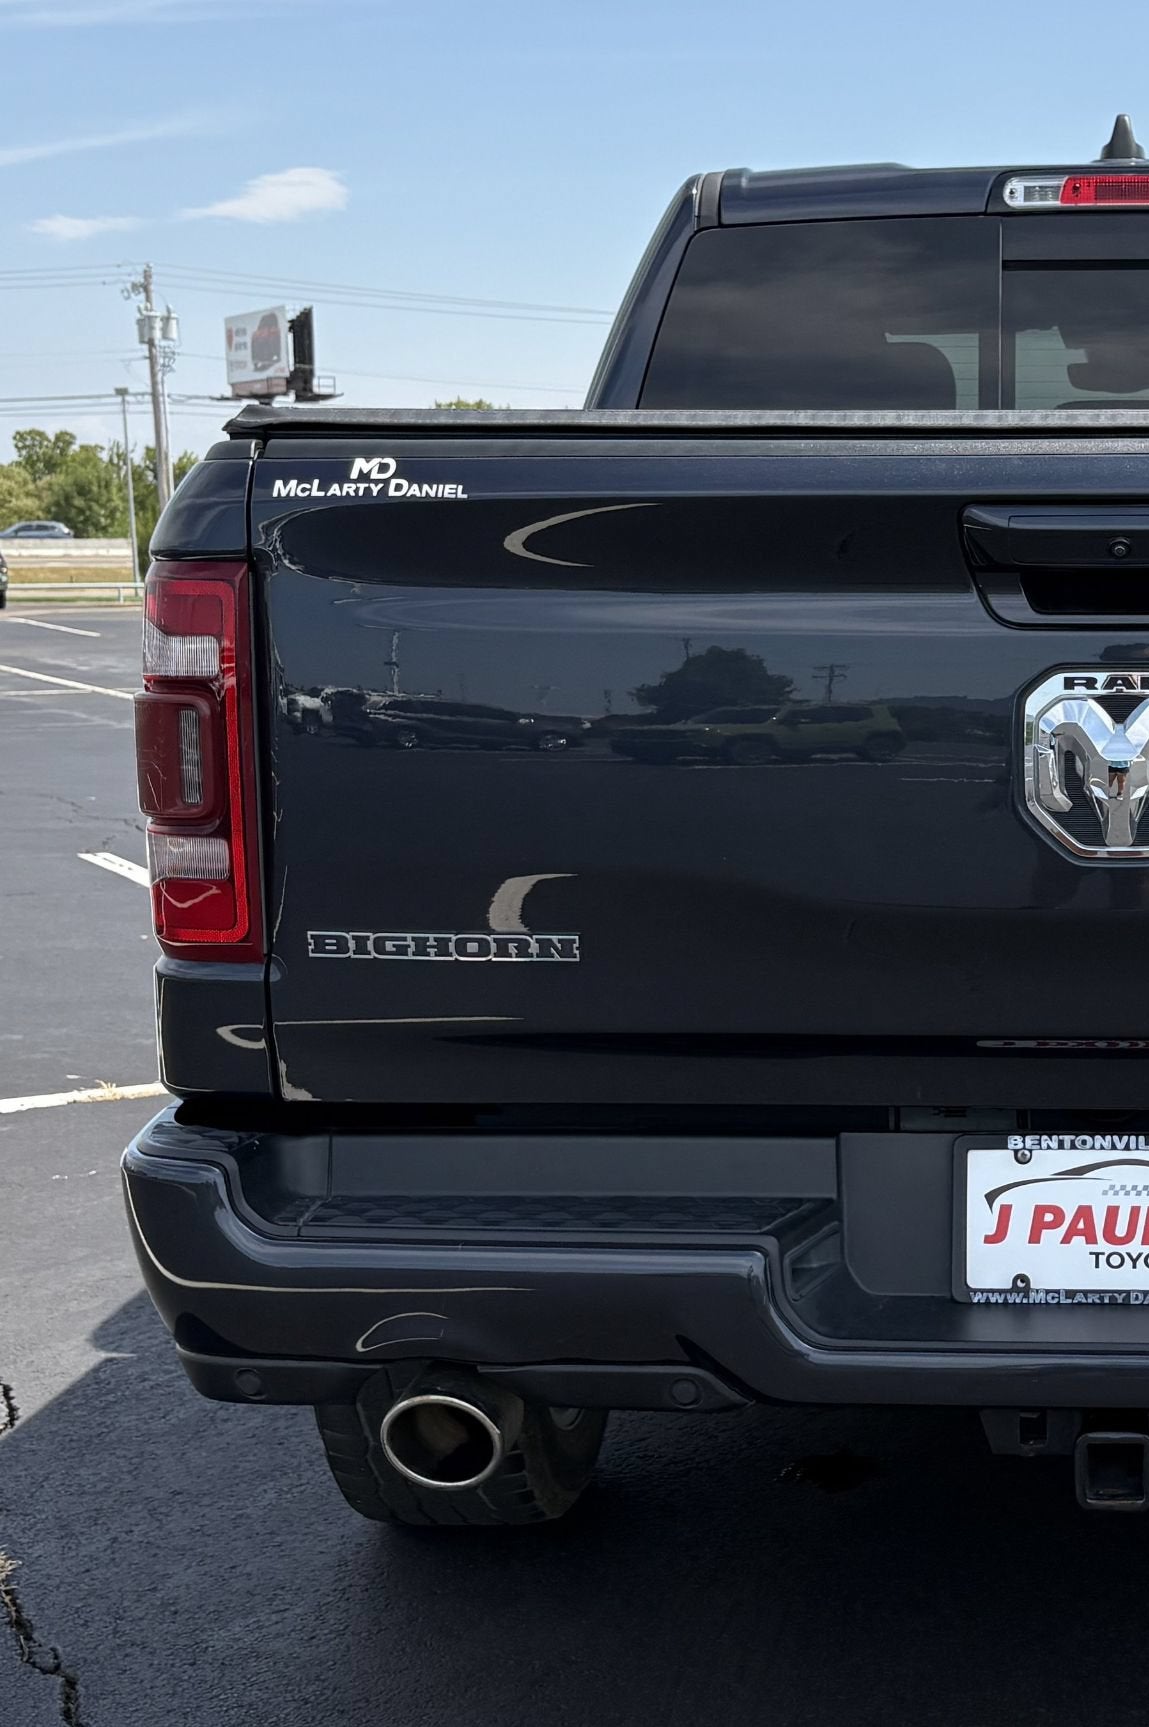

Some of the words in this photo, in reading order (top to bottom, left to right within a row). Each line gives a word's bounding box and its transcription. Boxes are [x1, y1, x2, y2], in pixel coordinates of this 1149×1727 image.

[388, 479, 468, 498] DANIEL
[307, 931, 580, 961] BIGHORN
[983, 1204, 1013, 1244] J
